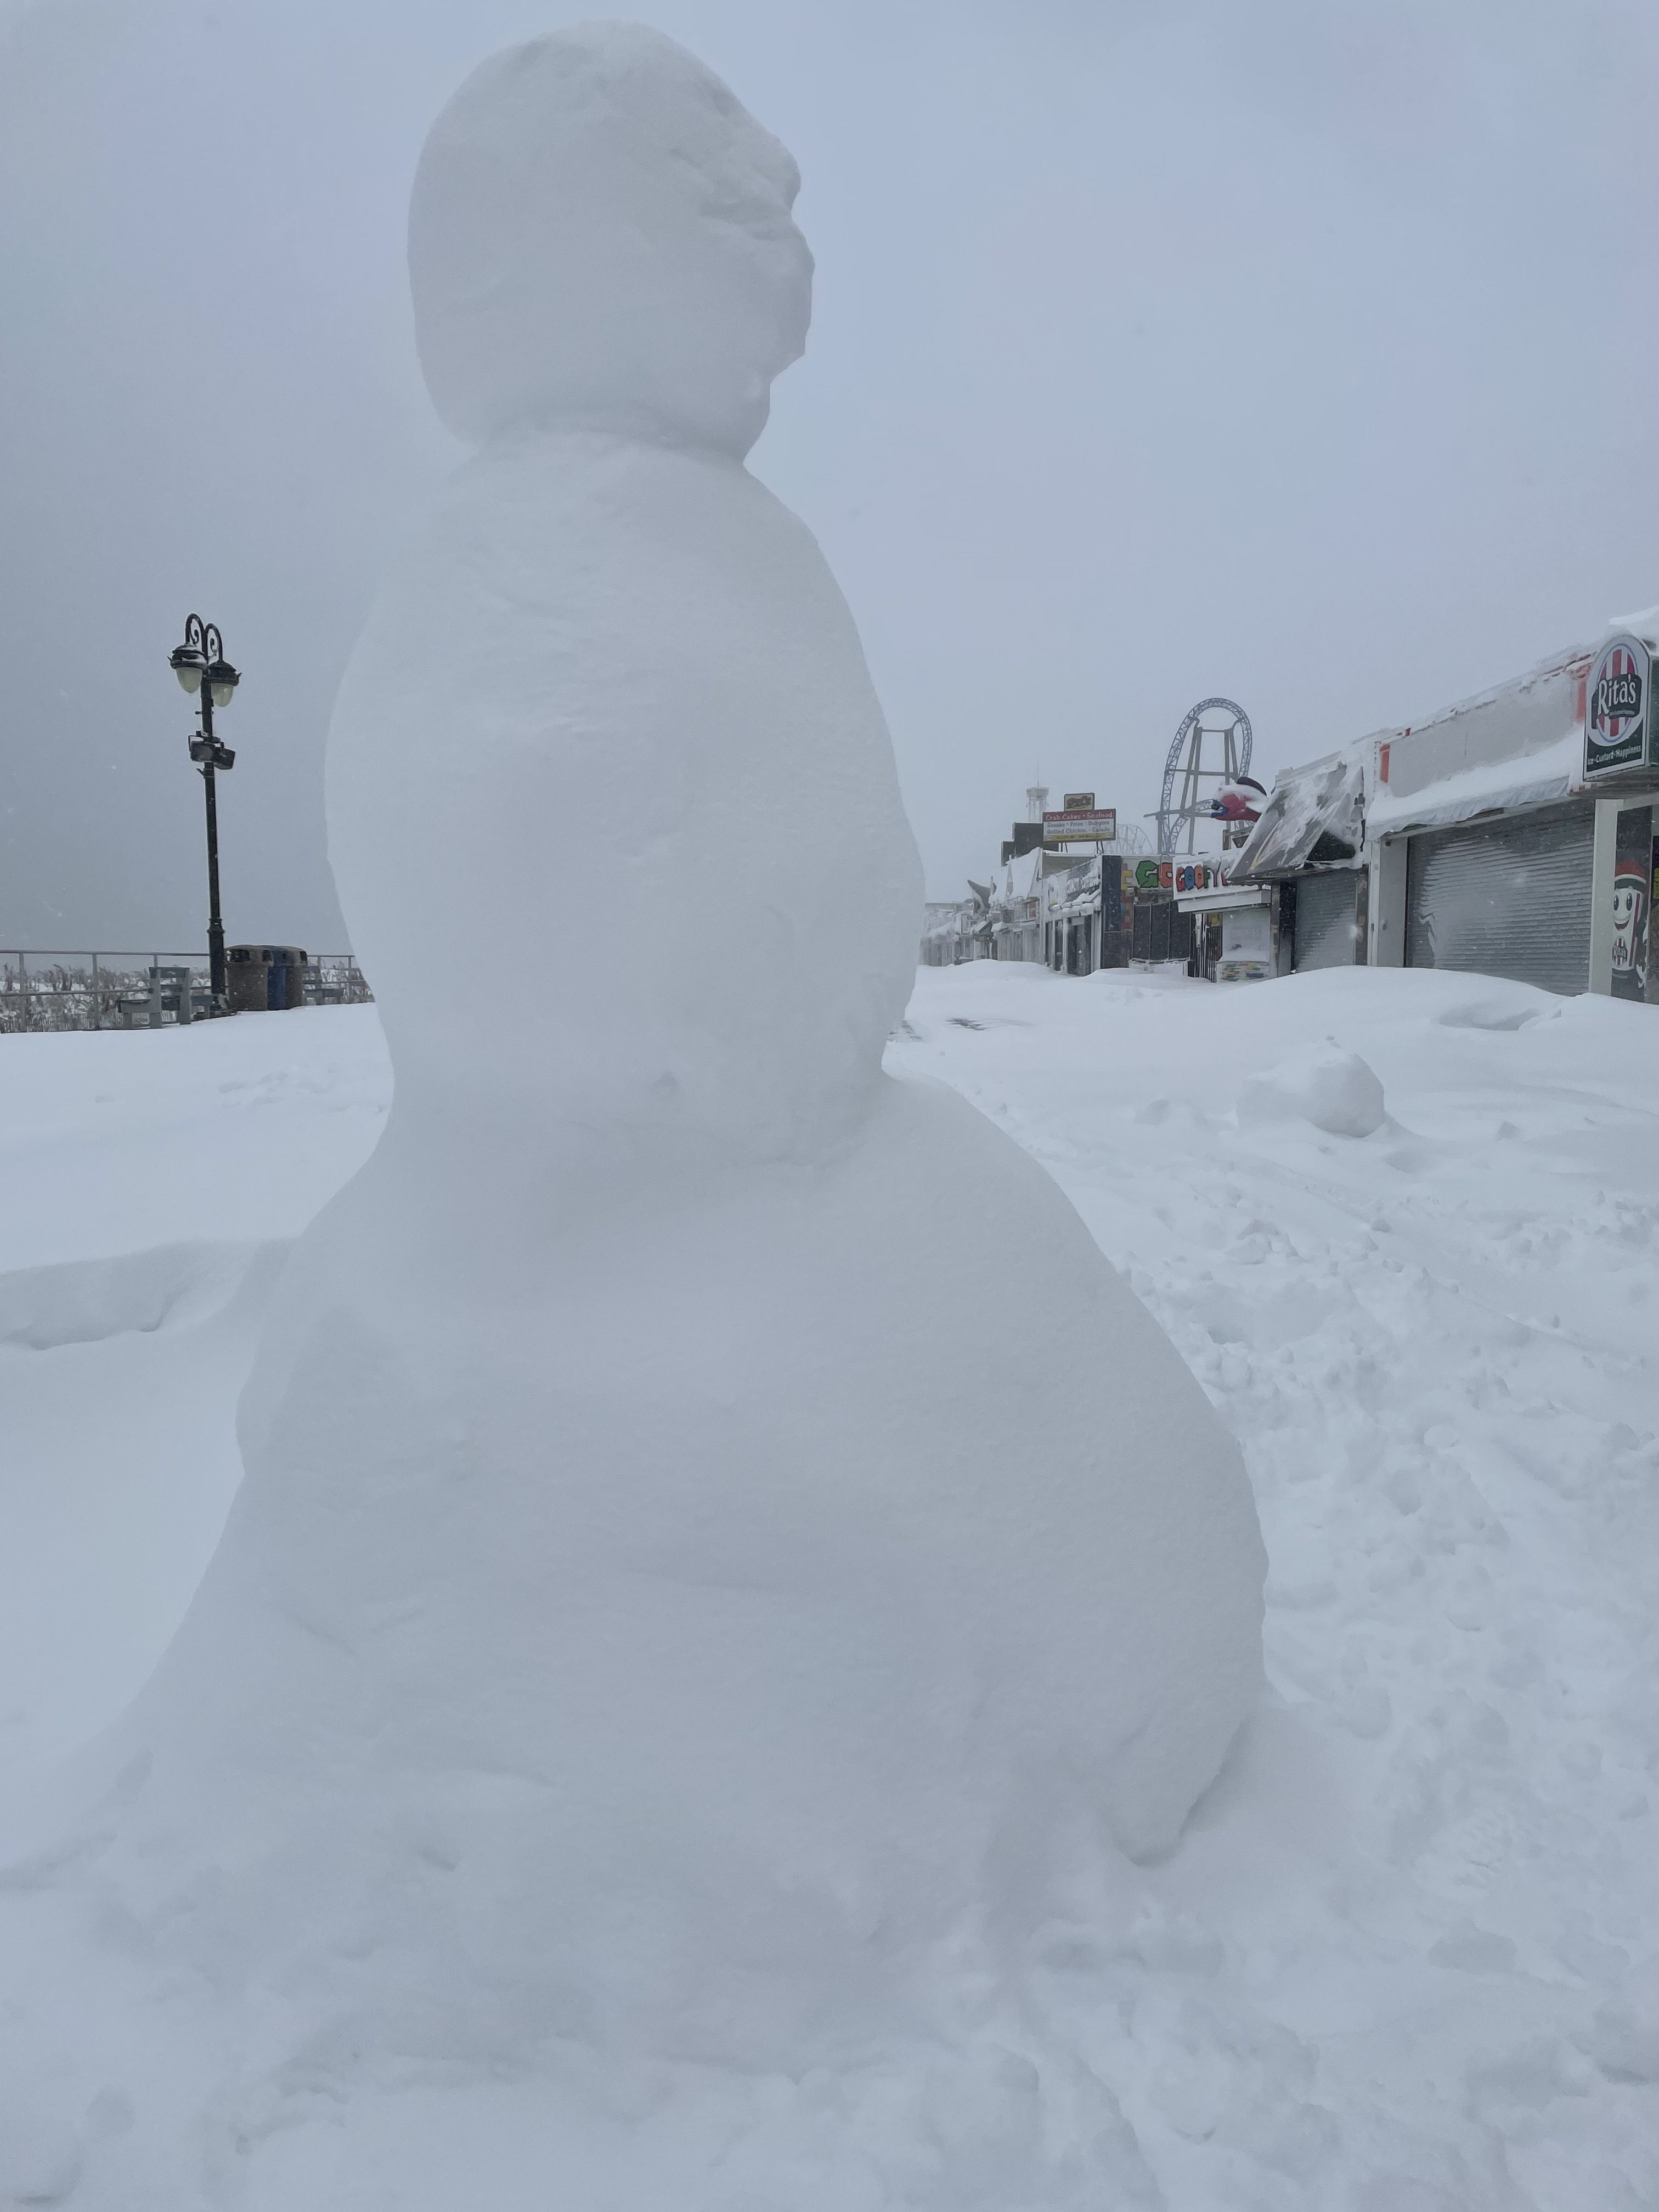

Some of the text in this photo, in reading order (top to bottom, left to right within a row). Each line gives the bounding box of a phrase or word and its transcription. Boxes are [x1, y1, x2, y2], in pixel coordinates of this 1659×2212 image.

[1598, 674, 1636, 715] Rita's
[1596, 749, 1613, 763] Custard
[1616, 745, 1641, 759] Happiness
